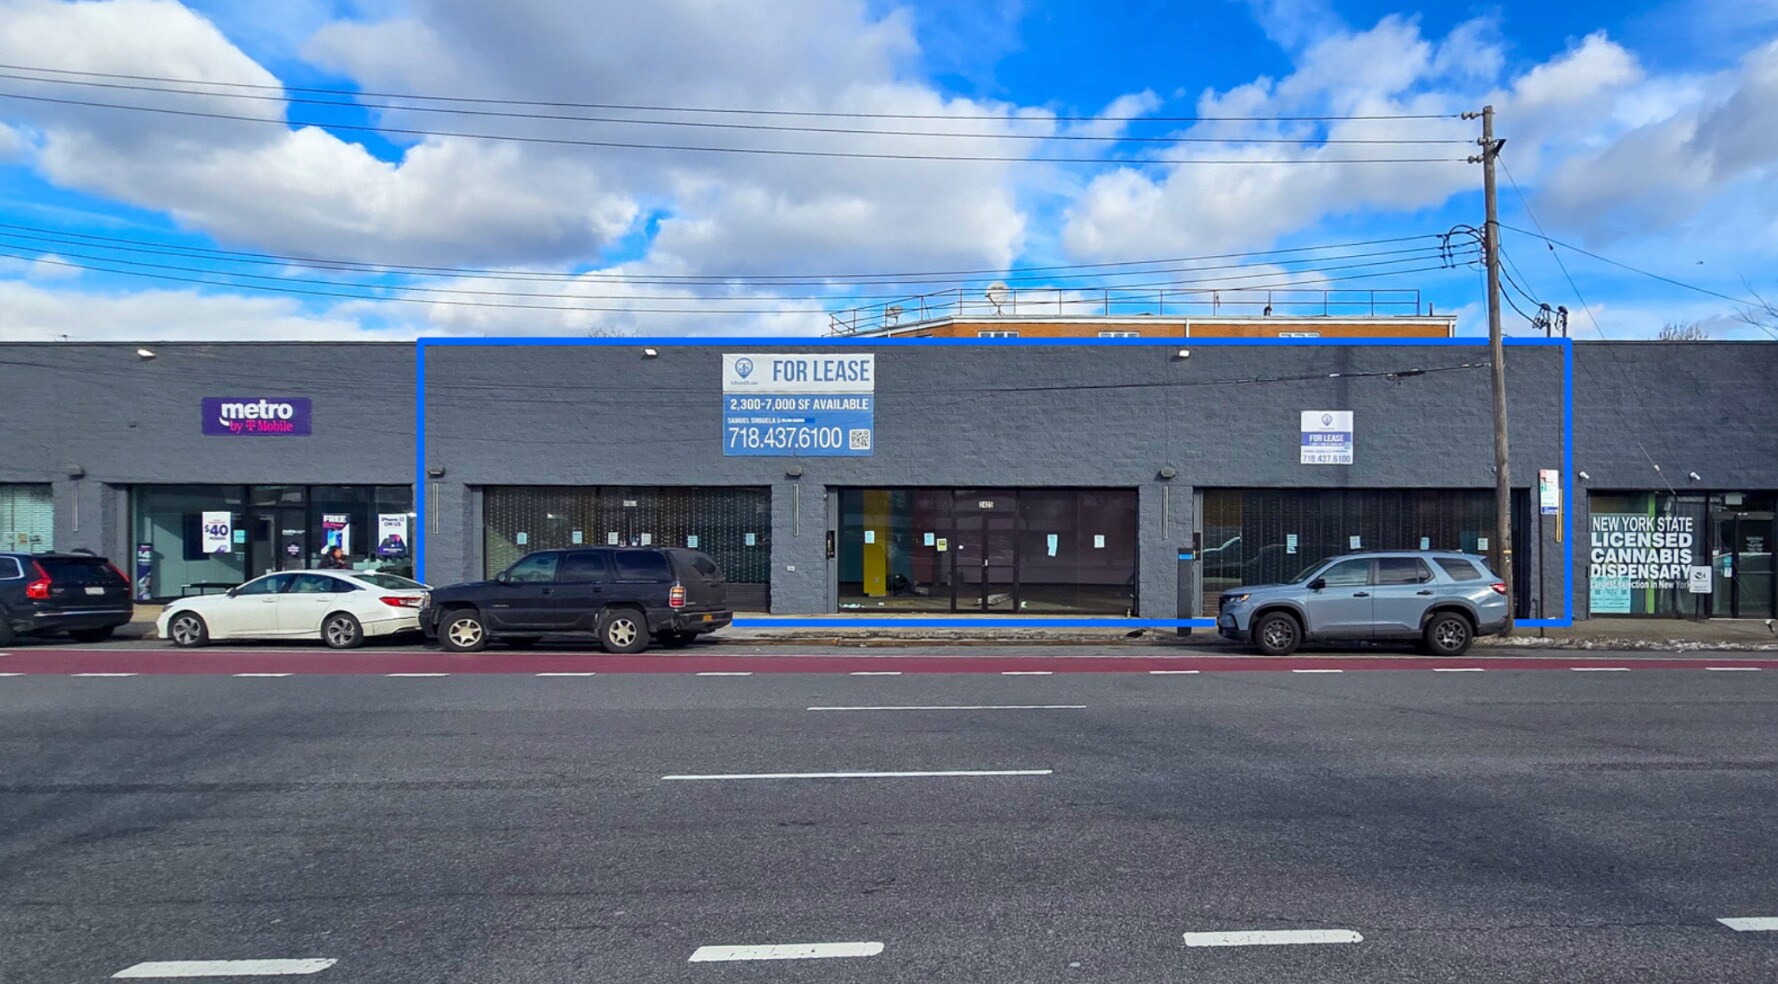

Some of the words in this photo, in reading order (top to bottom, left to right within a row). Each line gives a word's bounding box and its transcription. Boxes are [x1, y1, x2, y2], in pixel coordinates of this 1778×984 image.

[773, 360, 807, 382] FOR
[813, 360, 871, 382] LEASE
[221, 399, 293, 419] metro
[730, 398, 796, 411] 2,300-7,000
[798, 398, 810, 411] SF
[812, 398, 869, 410] AVAILABLE
[230, 420, 242, 433] by
[258, 420, 293, 432] Mobile
[728, 427, 843, 449] 718.437.6100
[1309, 434, 1322, 442] FOR
[1323, 434, 1344, 442] LEASE
[1303, 454, 1351, 462] 718.437.6100
[204, 524, 229, 536] $40
[1593, 517, 1619, 532] NEW
[1622, 517, 1655, 532] YORK
[1657, 517, 1693, 532] STATE
[1591, 532, 1693, 547] LICENSED
[1591, 548, 1693, 563] CANNABIS
[1591, 564, 1692, 579] DISPENSARY
[1659, 580, 1674, 588] New
